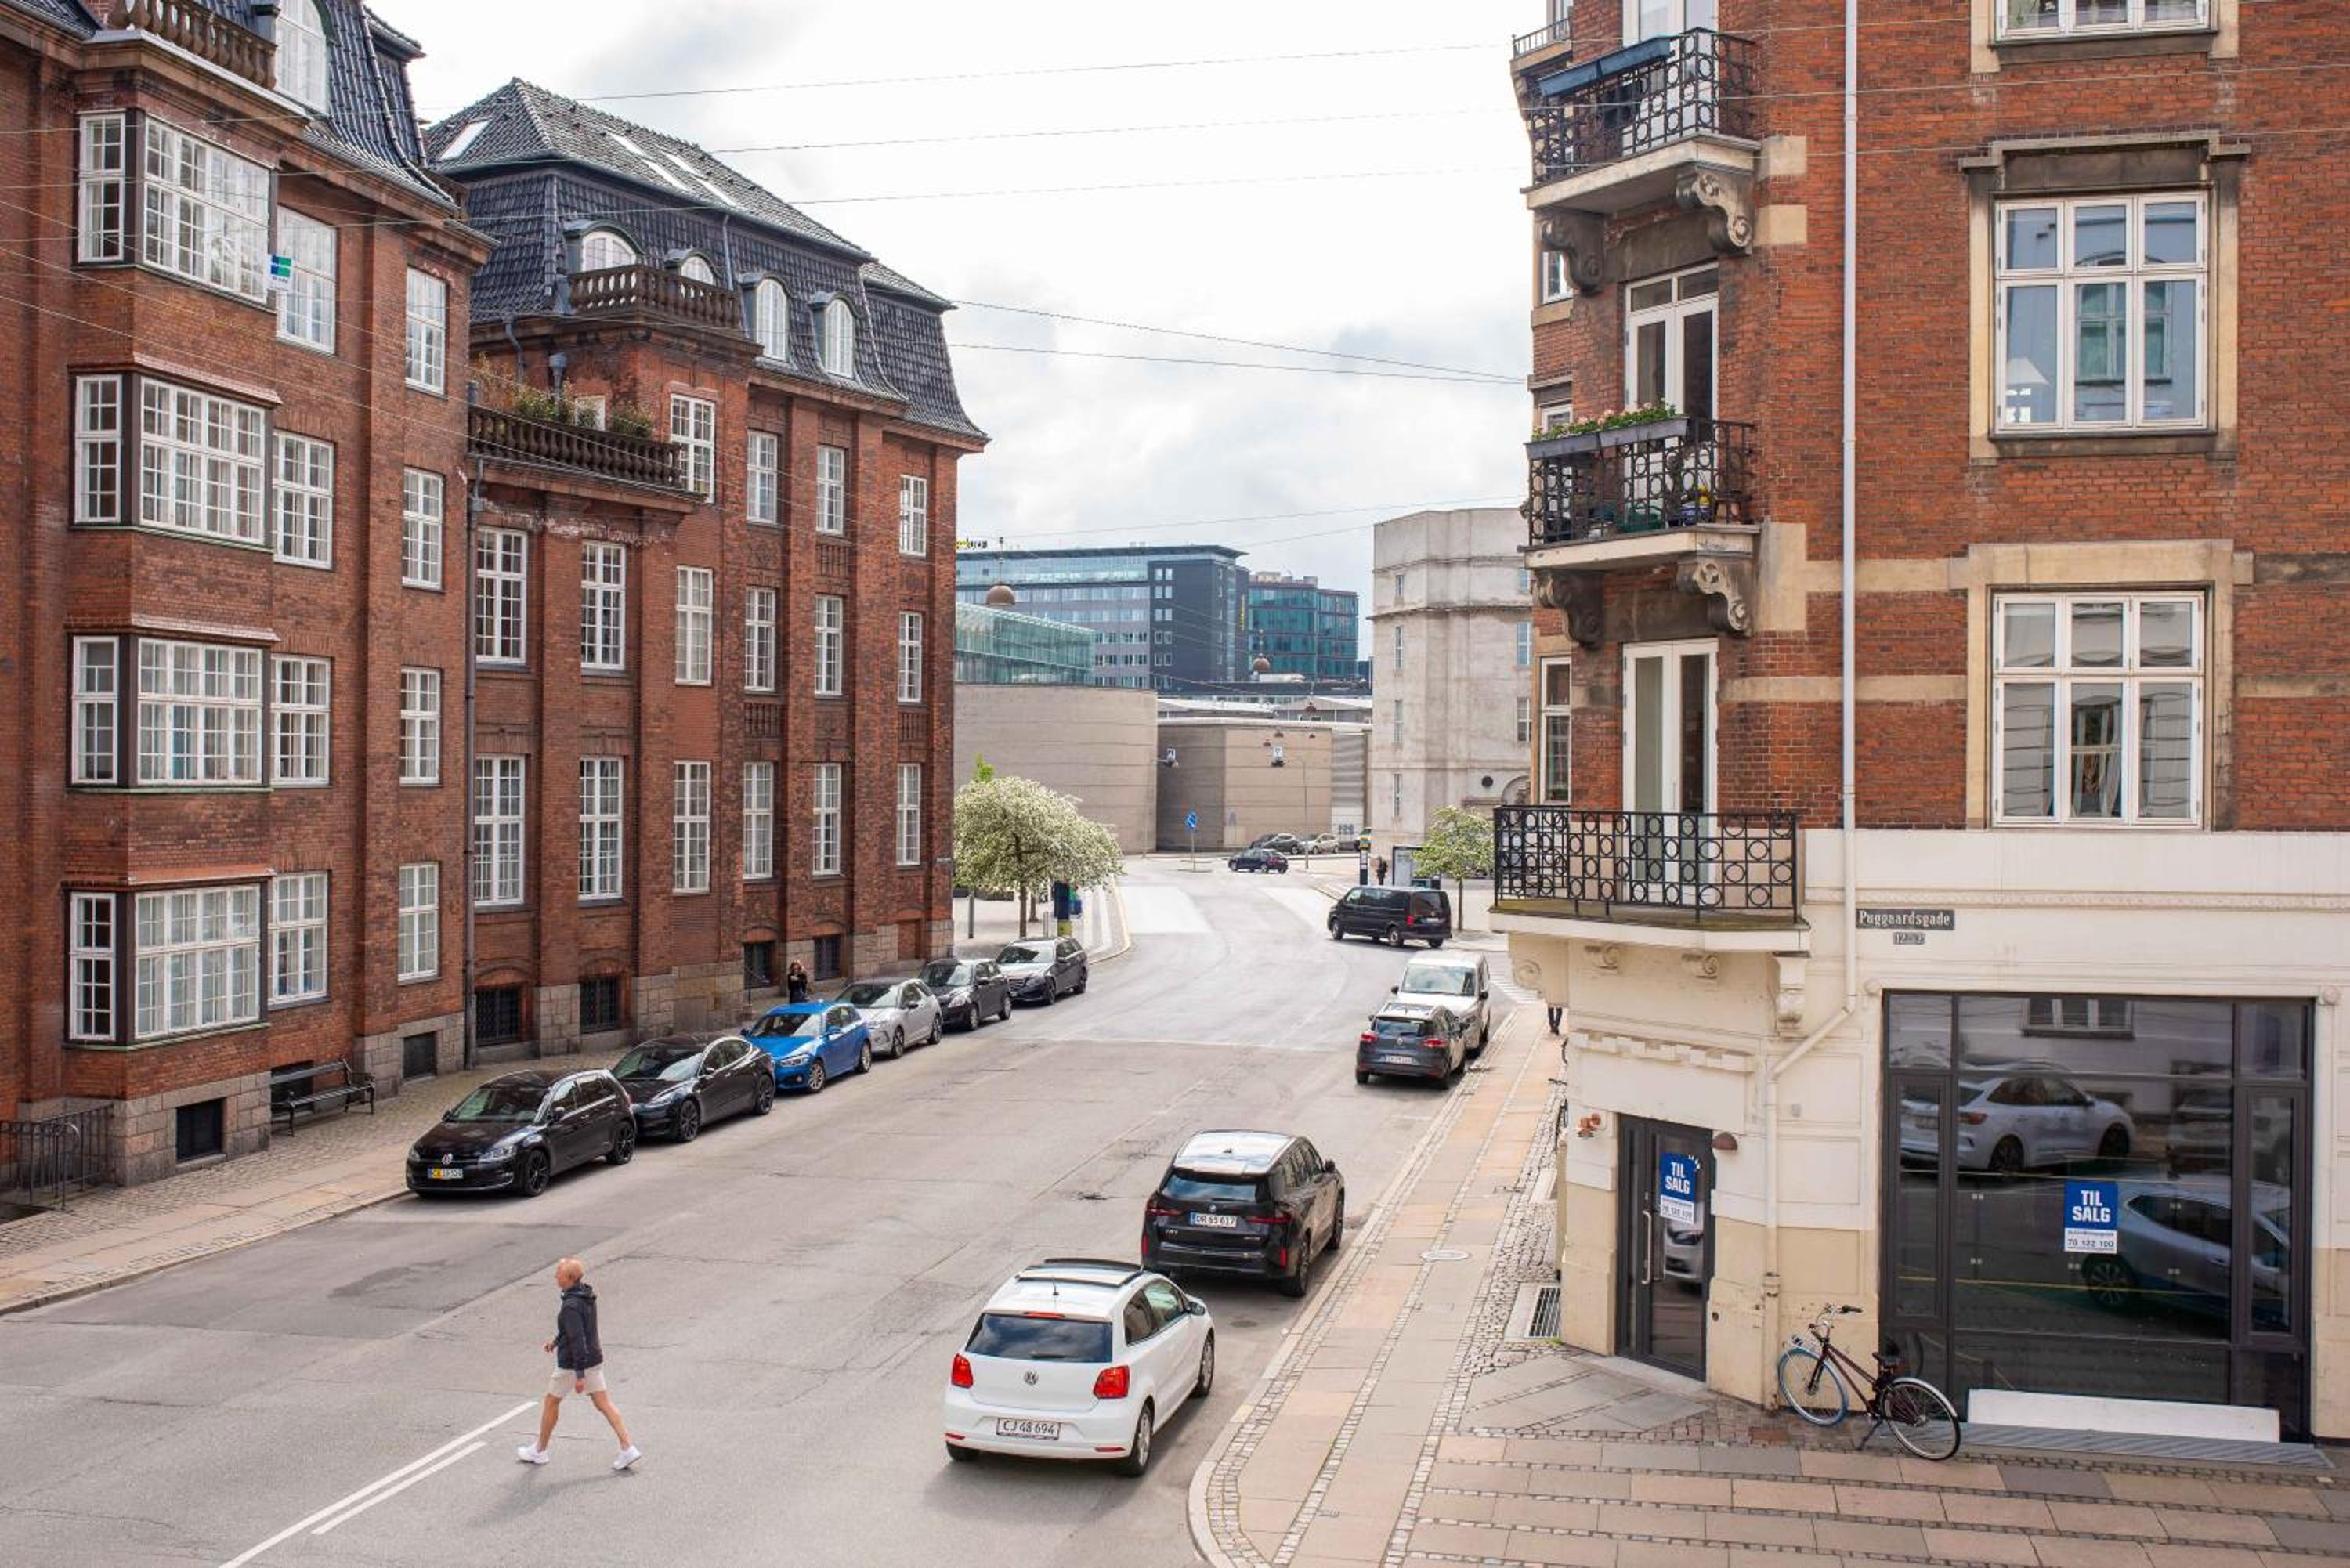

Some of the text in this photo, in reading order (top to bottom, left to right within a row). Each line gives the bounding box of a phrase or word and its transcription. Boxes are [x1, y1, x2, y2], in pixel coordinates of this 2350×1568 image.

[1859, 909, 1950, 927] Puggaardsgade
[1671, 1162, 1686, 1178] TIL
[1665, 1176, 1690, 1194] SALG
[2081, 1190, 2103, 1206] TIL
[2072, 1205, 2111, 1223] SALG
[1003, 1420, 1055, 1434] CJ 48 694
